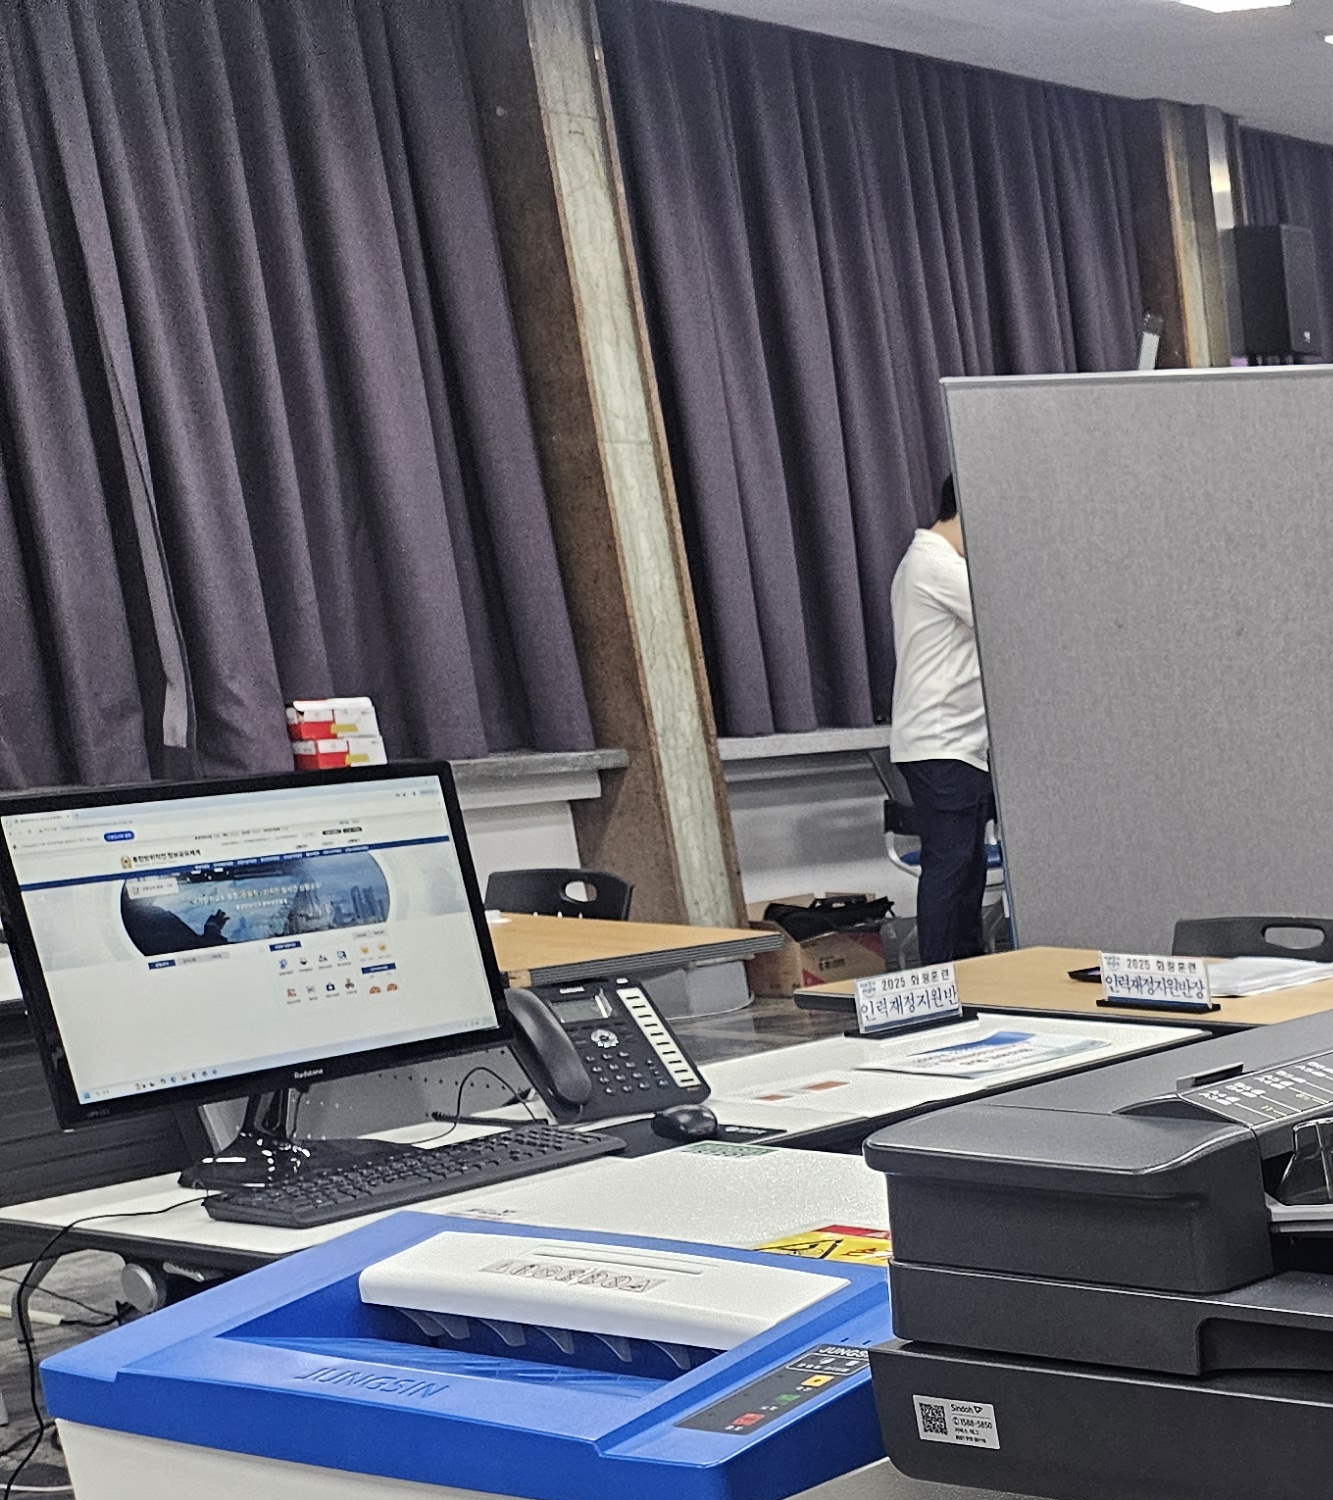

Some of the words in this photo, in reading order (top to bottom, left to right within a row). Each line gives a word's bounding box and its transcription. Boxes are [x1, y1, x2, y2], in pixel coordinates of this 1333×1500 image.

[1126, 958, 1150, 970] 2025
[882, 976, 905, 991] 2025
[1105, 973, 1205, 999] 인력재정지원반장
[860, 985, 958, 1021] 인력재정지원반
[294, 1367, 449, 1398] JUNGSIN
[951, 1403, 974, 1414] Sindoh
